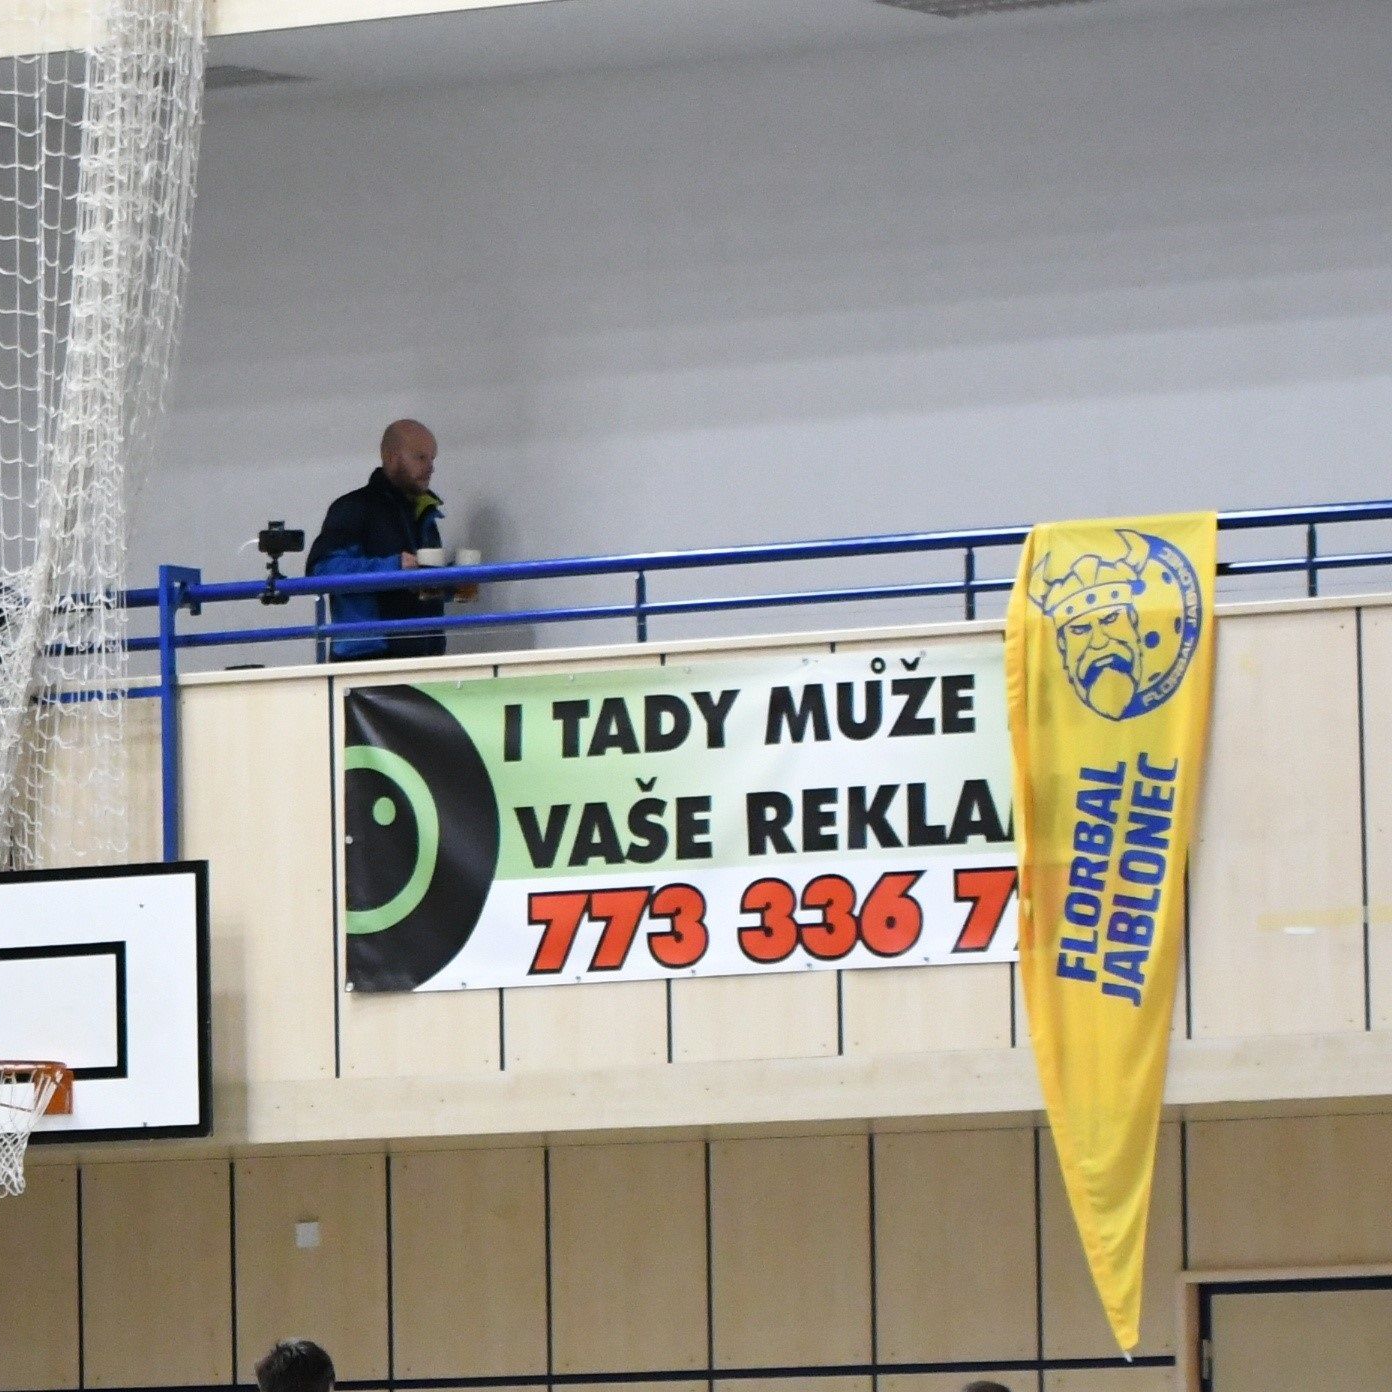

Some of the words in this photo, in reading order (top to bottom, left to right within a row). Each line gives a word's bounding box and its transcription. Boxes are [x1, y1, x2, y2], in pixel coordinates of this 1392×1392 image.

[503, 703, 523, 763] I
[552, 689, 740, 760] TADY
[764, 657, 976, 746] MŮŽE
[514, 777, 713, 869] VAŠE
[1056, 761, 1127, 983] FLORBAL
[527, 882, 709, 977] 773
[738, 870, 927, 965] 336
[951, 865, 1019, 955] 7
[1101, 752, 1179, 1007] JABLONEC
